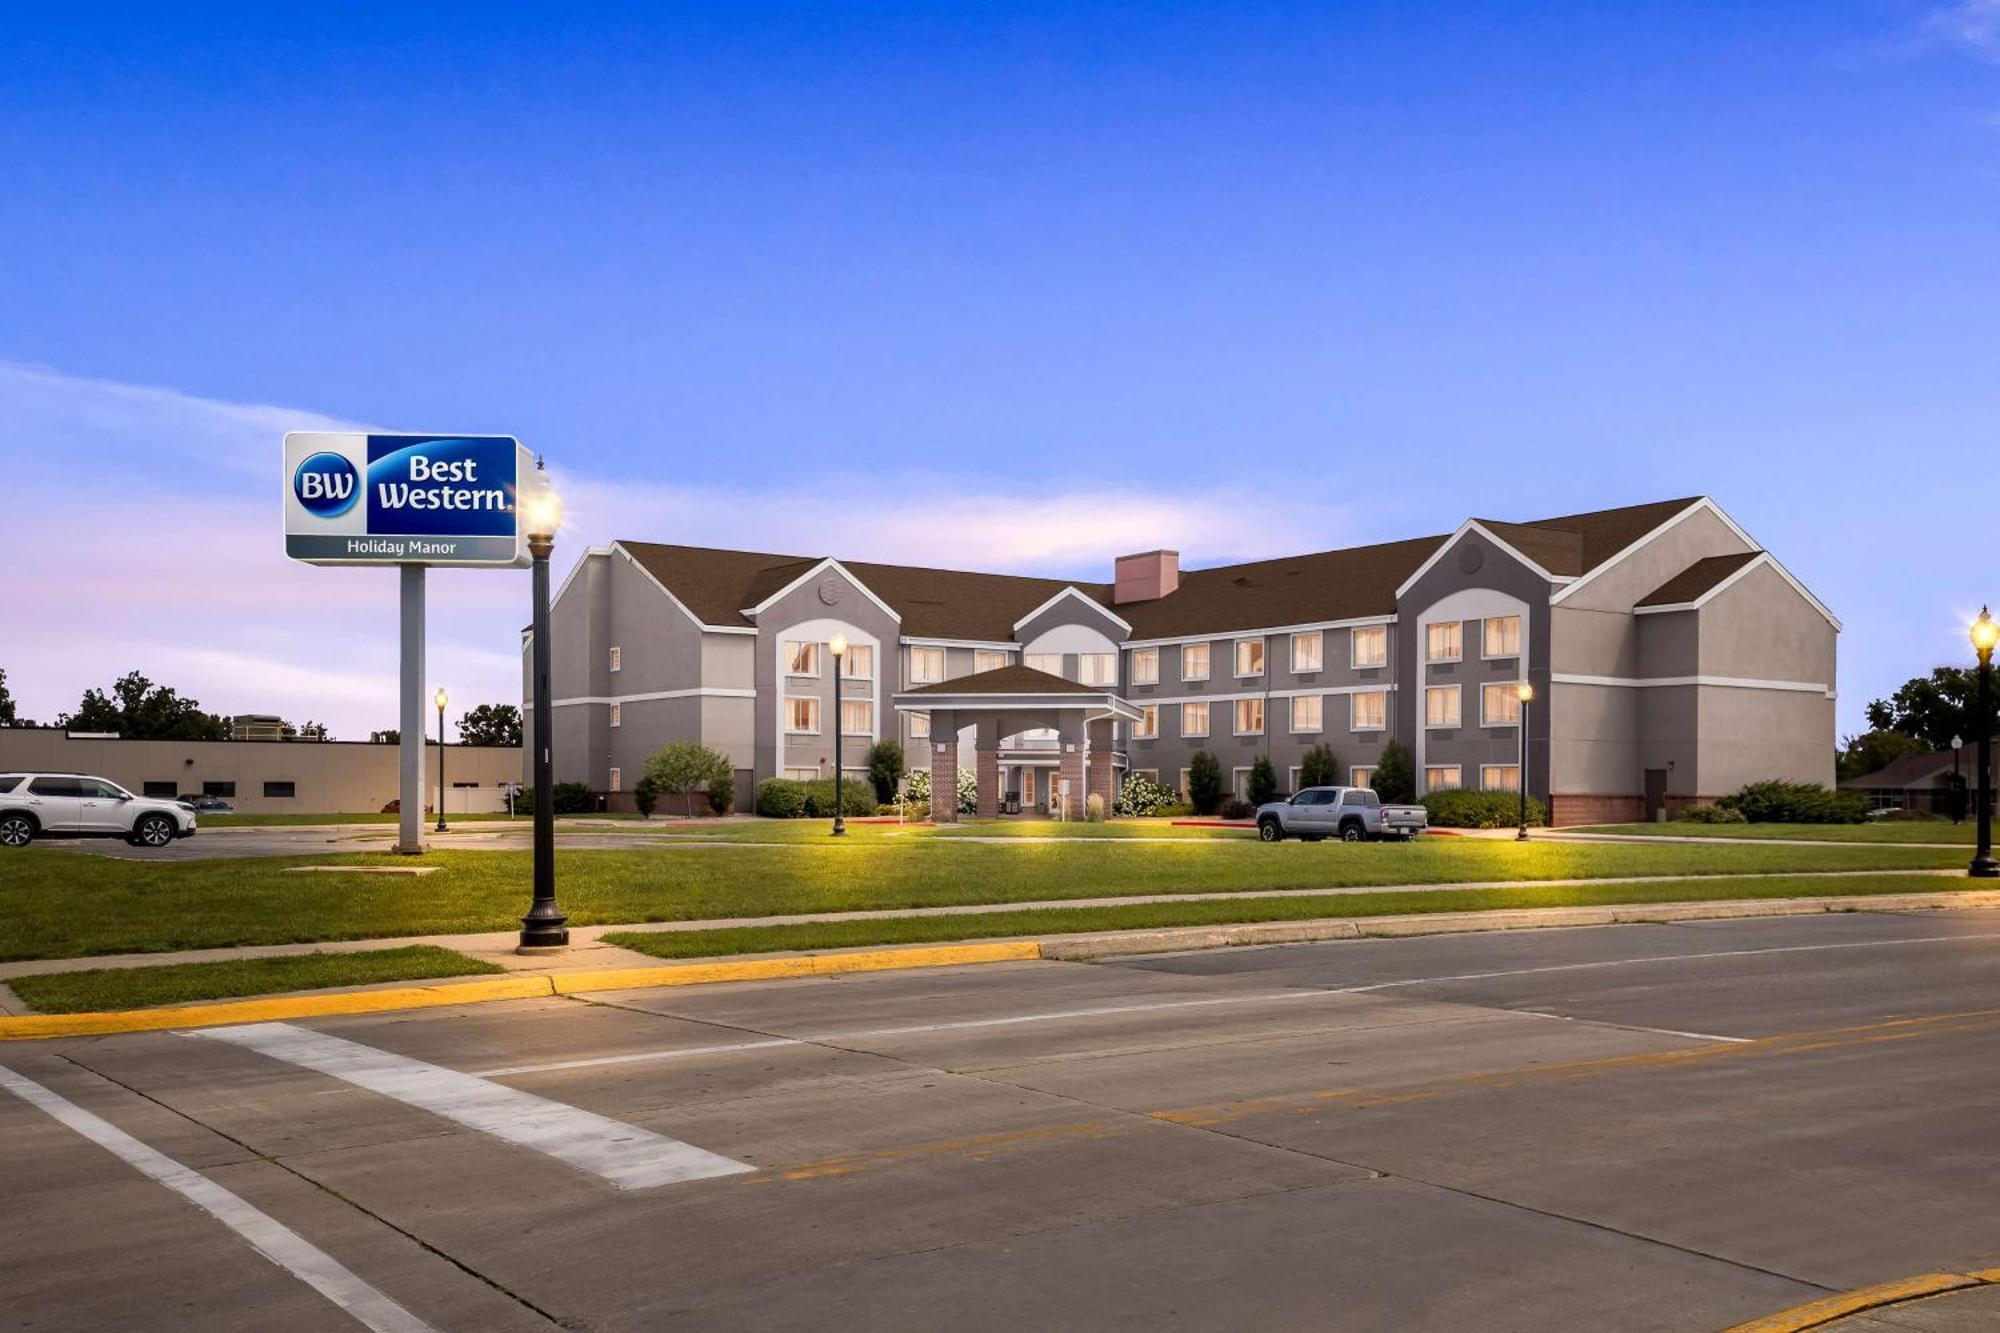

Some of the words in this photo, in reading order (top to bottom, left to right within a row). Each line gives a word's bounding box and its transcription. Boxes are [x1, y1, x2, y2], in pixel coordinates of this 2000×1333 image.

[410, 455, 478, 482] Best
[302, 472, 354, 499] BW
[347, 540, 405, 555] Holiday
[409, 541, 457, 554] Manor
